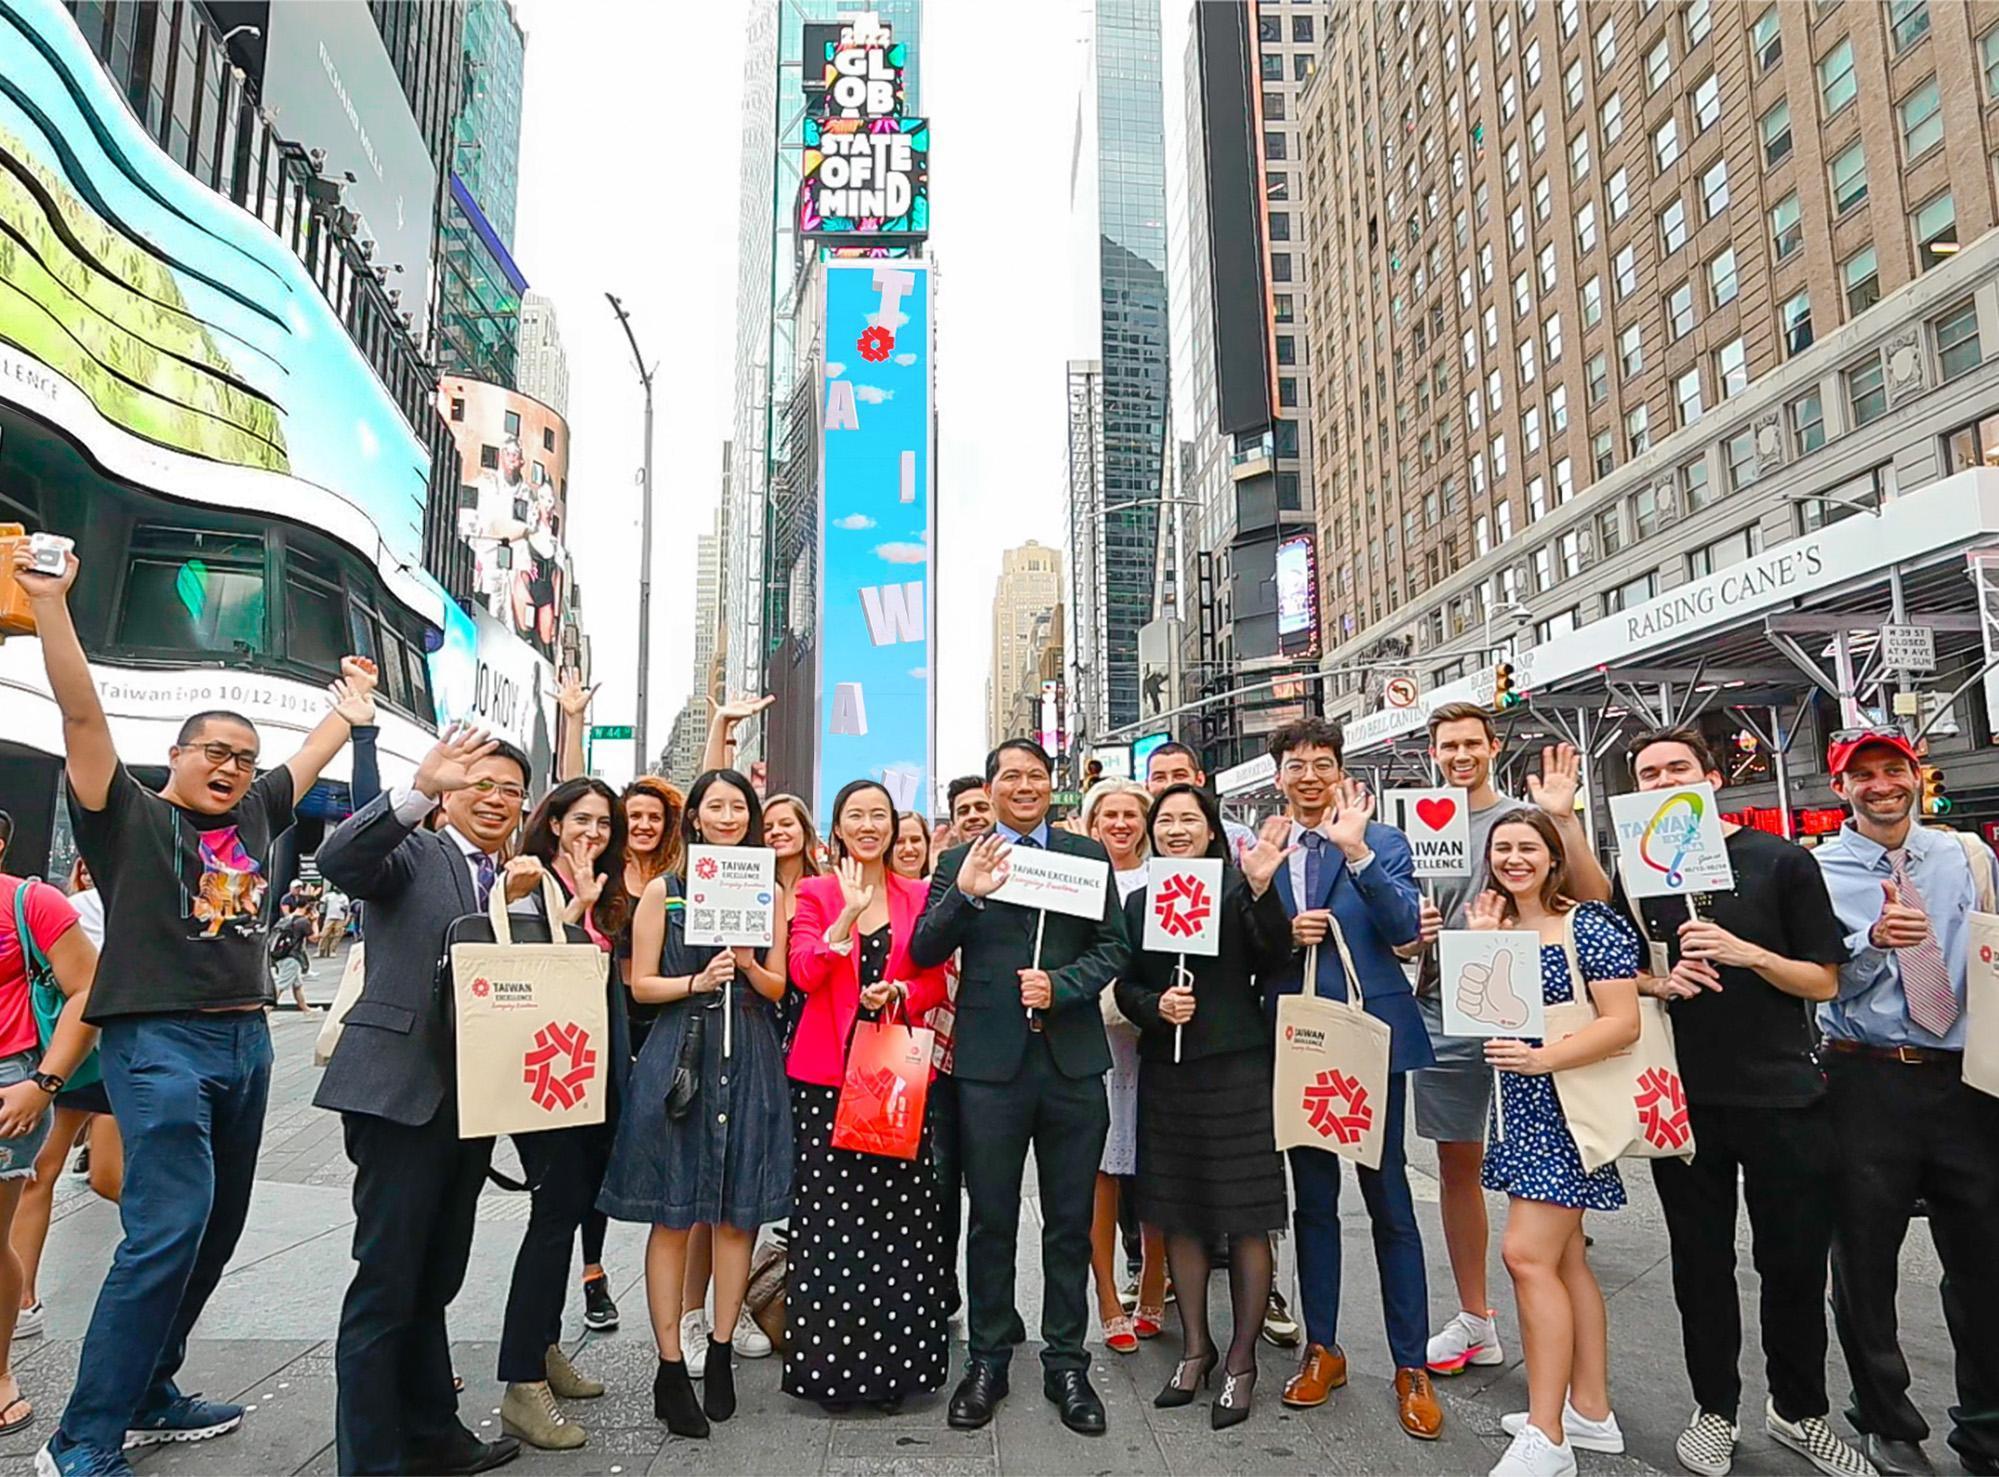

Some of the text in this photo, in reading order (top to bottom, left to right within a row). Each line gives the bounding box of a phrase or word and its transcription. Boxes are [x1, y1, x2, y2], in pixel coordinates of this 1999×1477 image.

[820, 132, 913, 189] STATE
[820, 156, 873, 189] OF
[819, 171, 912, 218] MIND
[1627, 545, 1822, 642] RAISING CANE'S
[1888, 647, 1899, 655] AT
[1912, 648, 1930, 656] AVE
[491, 670, 519, 732] KOY
[606, 727, 620, 738] 44
[1396, 798, 1406, 833] I
[720, 861, 760, 872] TAIWAN
[1013, 863, 1101, 889] TAIWAN EXCELLENCE
[492, 982, 533, 993] TAIWAN
